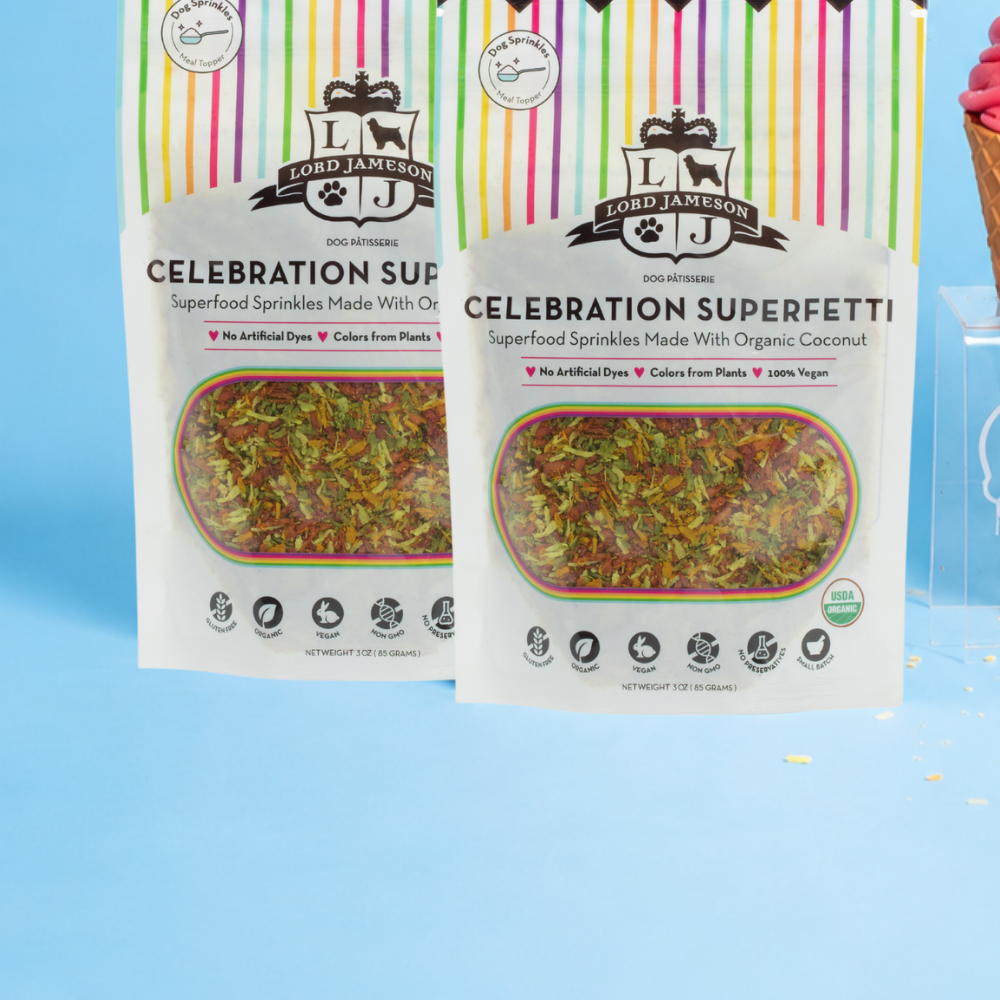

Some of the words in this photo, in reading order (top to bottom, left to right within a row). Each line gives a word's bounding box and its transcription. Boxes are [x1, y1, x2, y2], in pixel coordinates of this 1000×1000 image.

[170, 3, 191, 20] Dog
[488, 40, 508, 57] Dog
[508, 36, 550, 59] Sprinkles
[179, 53, 197, 66] Meal
[198, 54, 225, 68] Topper
[496, 90, 514, 103] Meal
[516, 91, 542, 105] Topper
[321, 120, 349, 151] L
[289, 159, 340, 180] LORD
[343, 158, 432, 182] JAMESON
[638, 157, 666, 188] L
[373, 180, 401, 208] J
[606, 196, 656, 217] LORD
[660, 194, 748, 220] JAMESON
[689, 217, 717, 245] J
[326, 238, 349, 247] DOG
[350, 236, 399, 247] PÂTISSERIE
[146, 259, 369, 285] CELEBRATION
[643, 274, 665, 283] DOG
[667, 272, 715, 284] PÂTISSERIE
[171, 294, 249, 313] Superfood
[252, 295, 323, 314] Sprinkles
[328, 295, 373, 310] Made
[377, 295, 414, 310] With
[418, 296, 440, 313] Or
[464, 295, 685, 321] CELEBRATION
[697, 297, 893, 322] SUPERFETTI
[222, 331, 238, 341] No
[240, 331, 285, 341] Artificial
[286, 331, 313, 344] Dyes
[333, 331, 369, 342] Colors
[371, 331, 397, 342] from
[399, 331, 431, 342] Plants
[488, 330, 565, 349] Superfood
[569, 330, 640, 349] Sprinkles
[645, 331, 689, 346] Made
[694, 331, 730, 346] With
[734, 332, 795, 350] Organic
[799, 332, 868, 347] Coconut
[539, 367, 554, 377] No
[556, 366, 601, 377] Artificial
[603, 367, 629, 380] Dyes
[650, 367, 684, 378] Colors
[687, 367, 713, 378] from
[715, 367, 747, 378] Plants
[767, 369, 796, 378] 100%
[797, 367, 829, 380] Vegan
[830, 590, 854, 601] USDA
[827, 604, 858, 614] ORGANIC
[421, 614, 430, 627] NO
[254, 628, 283, 639] ORGANIC
[316, 631, 340, 639] VEGAN
[370, 628, 386, 639] NON
[387, 629, 405, 640] GMO
[571, 662, 600, 673] ORGANIC
[738, 649, 746, 661] NO
[744, 647, 786, 674] PRESERVATIVES
[796, 656, 815, 670] SMALL
[816, 653, 835, 671] BATCH
[632, 665, 656, 674] VEGAN
[686, 663, 703, 674] NON
[704, 663, 721, 674] GMO
